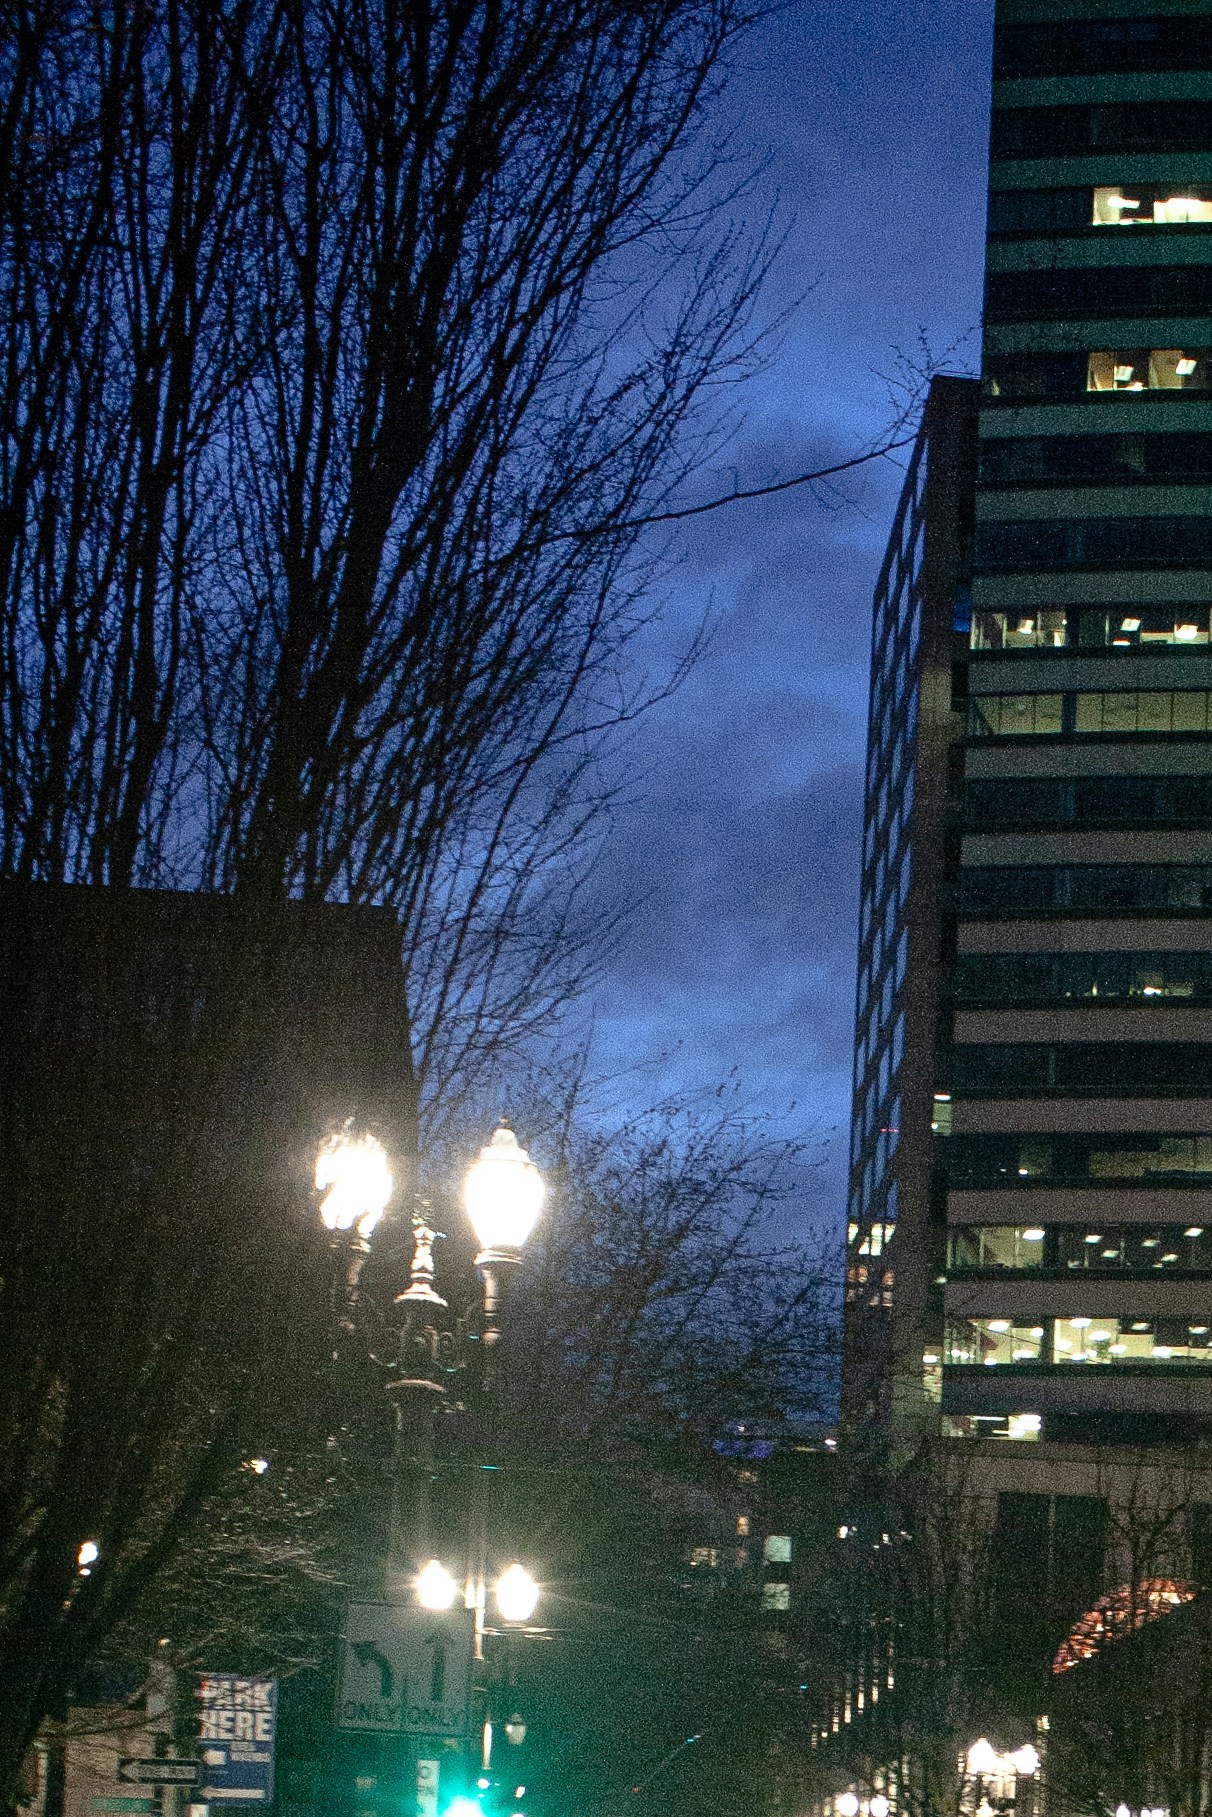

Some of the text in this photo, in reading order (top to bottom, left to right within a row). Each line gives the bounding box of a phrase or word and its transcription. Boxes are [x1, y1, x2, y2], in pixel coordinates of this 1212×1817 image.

[200, 1681, 273, 1710] PARK
[200, 1711, 273, 1741] HERE
[343, 1701, 465, 1727] ONLY ONLY
